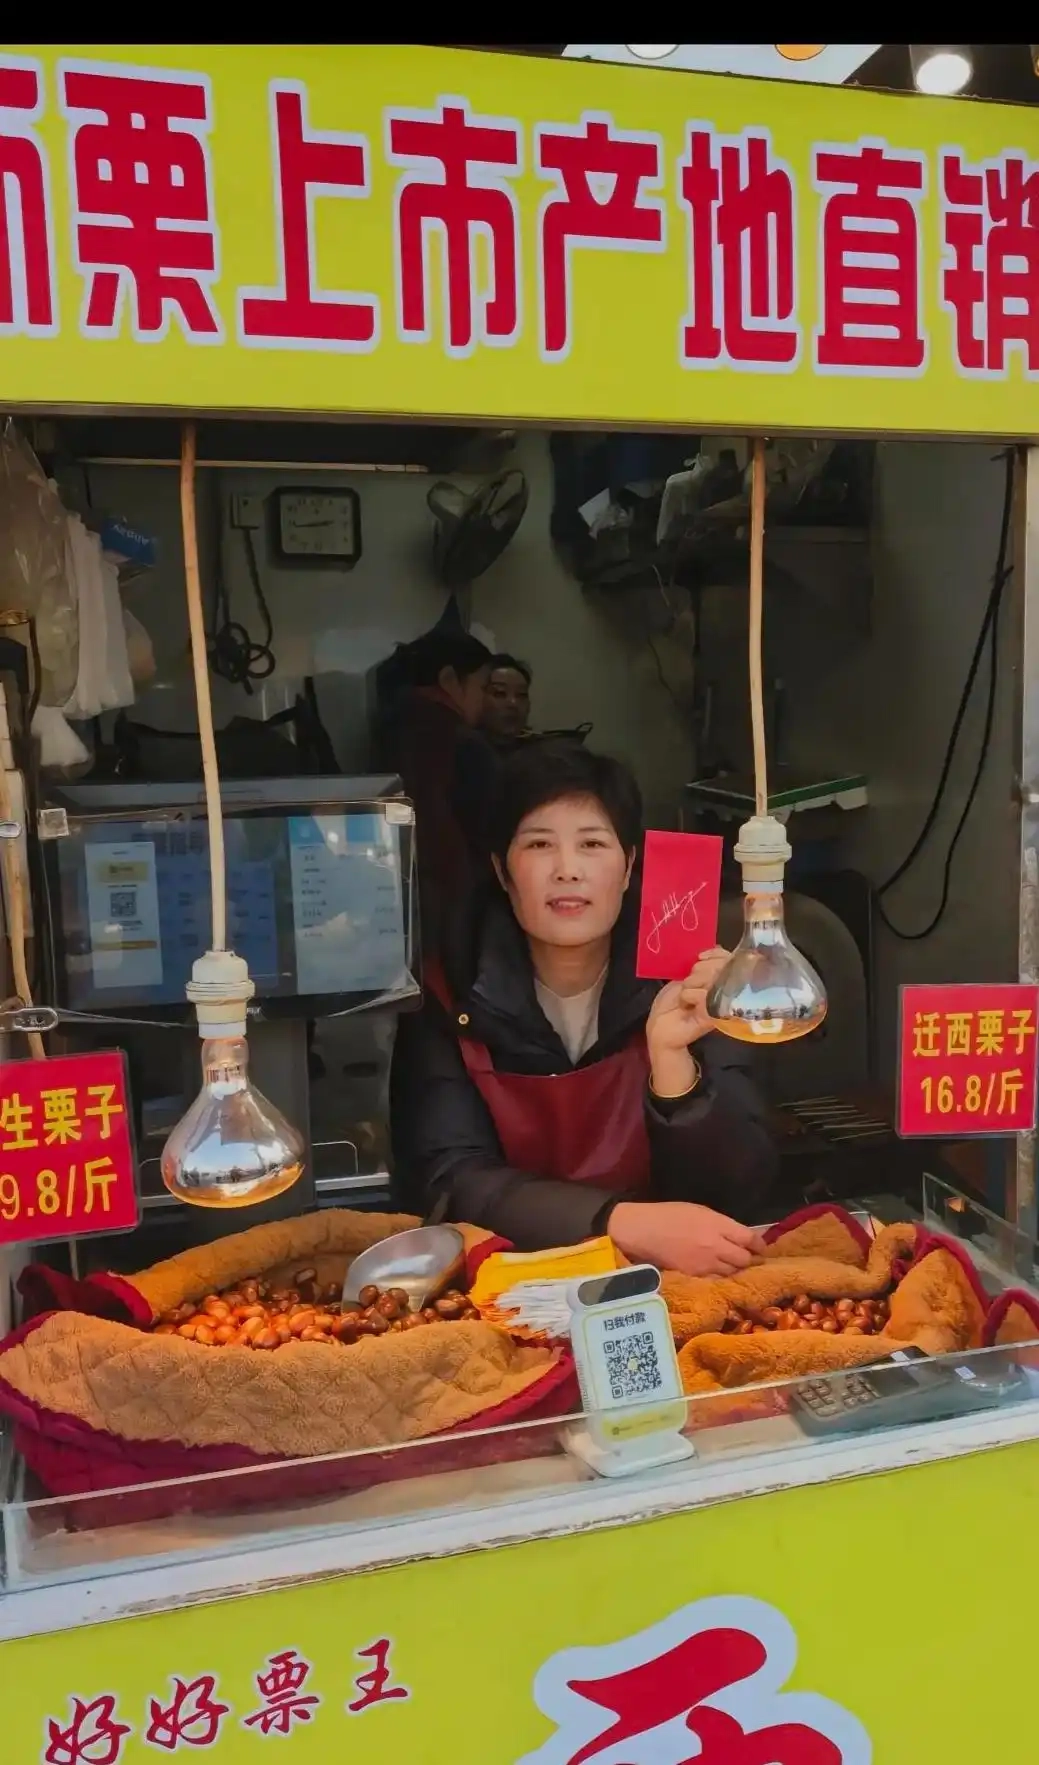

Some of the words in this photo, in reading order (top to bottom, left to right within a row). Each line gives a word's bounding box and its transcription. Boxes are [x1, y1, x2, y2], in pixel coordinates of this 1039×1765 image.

[912, 1010, 1035, 1057] 迁西栗子
[920, 1068, 1024, 1116] 16.8/斤
[0, 1084, 124, 1150] 生栗子
[603, 1311, 646, 1332] 扫我付款
